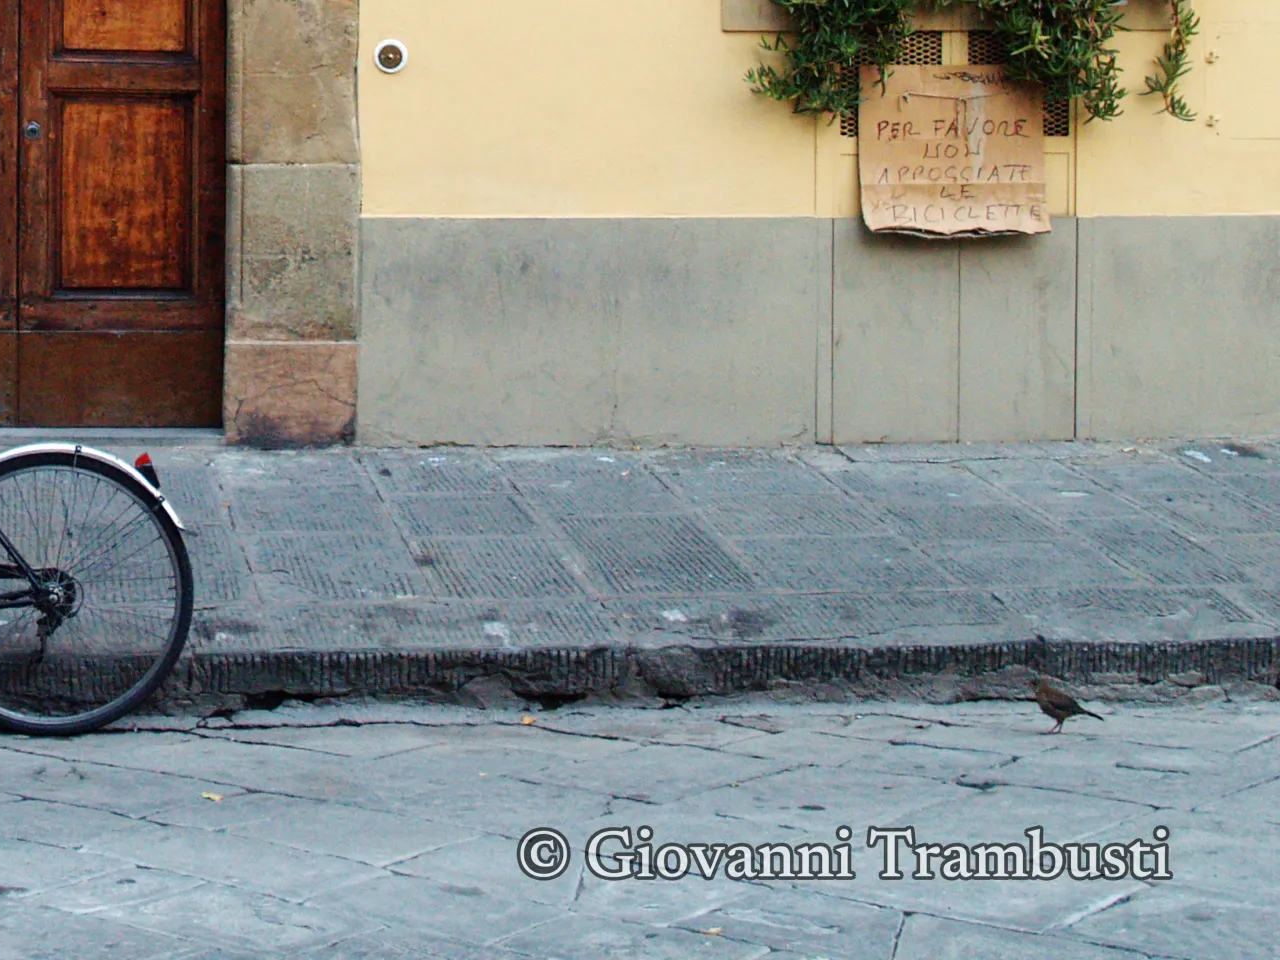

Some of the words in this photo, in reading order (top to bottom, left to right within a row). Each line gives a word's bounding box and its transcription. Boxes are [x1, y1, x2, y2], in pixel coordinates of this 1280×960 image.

[877, 119, 920, 141] PER
[932, 117, 1031, 141] FAVORE
[922, 139, 981, 159] NON
[939, 184, 976, 199] LE
[885, 203, 1043, 224] BICICLETTE
